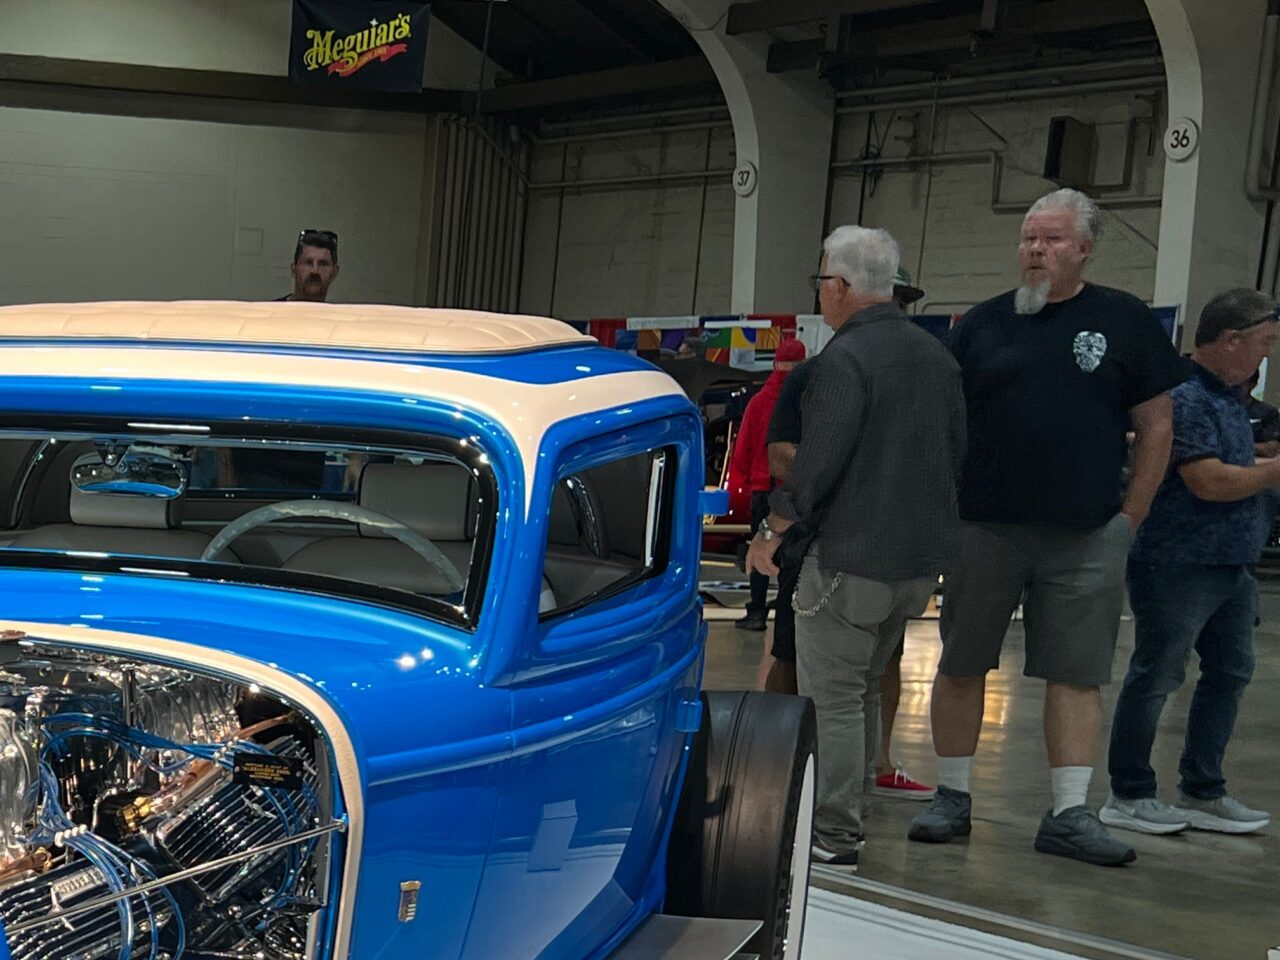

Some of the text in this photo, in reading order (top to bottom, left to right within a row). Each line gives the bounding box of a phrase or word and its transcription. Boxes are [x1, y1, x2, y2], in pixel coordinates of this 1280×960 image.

[304, 13, 411, 72] Meguiar's
[1170, 128, 1189, 149] 36
[737, 170, 750, 187] 37
